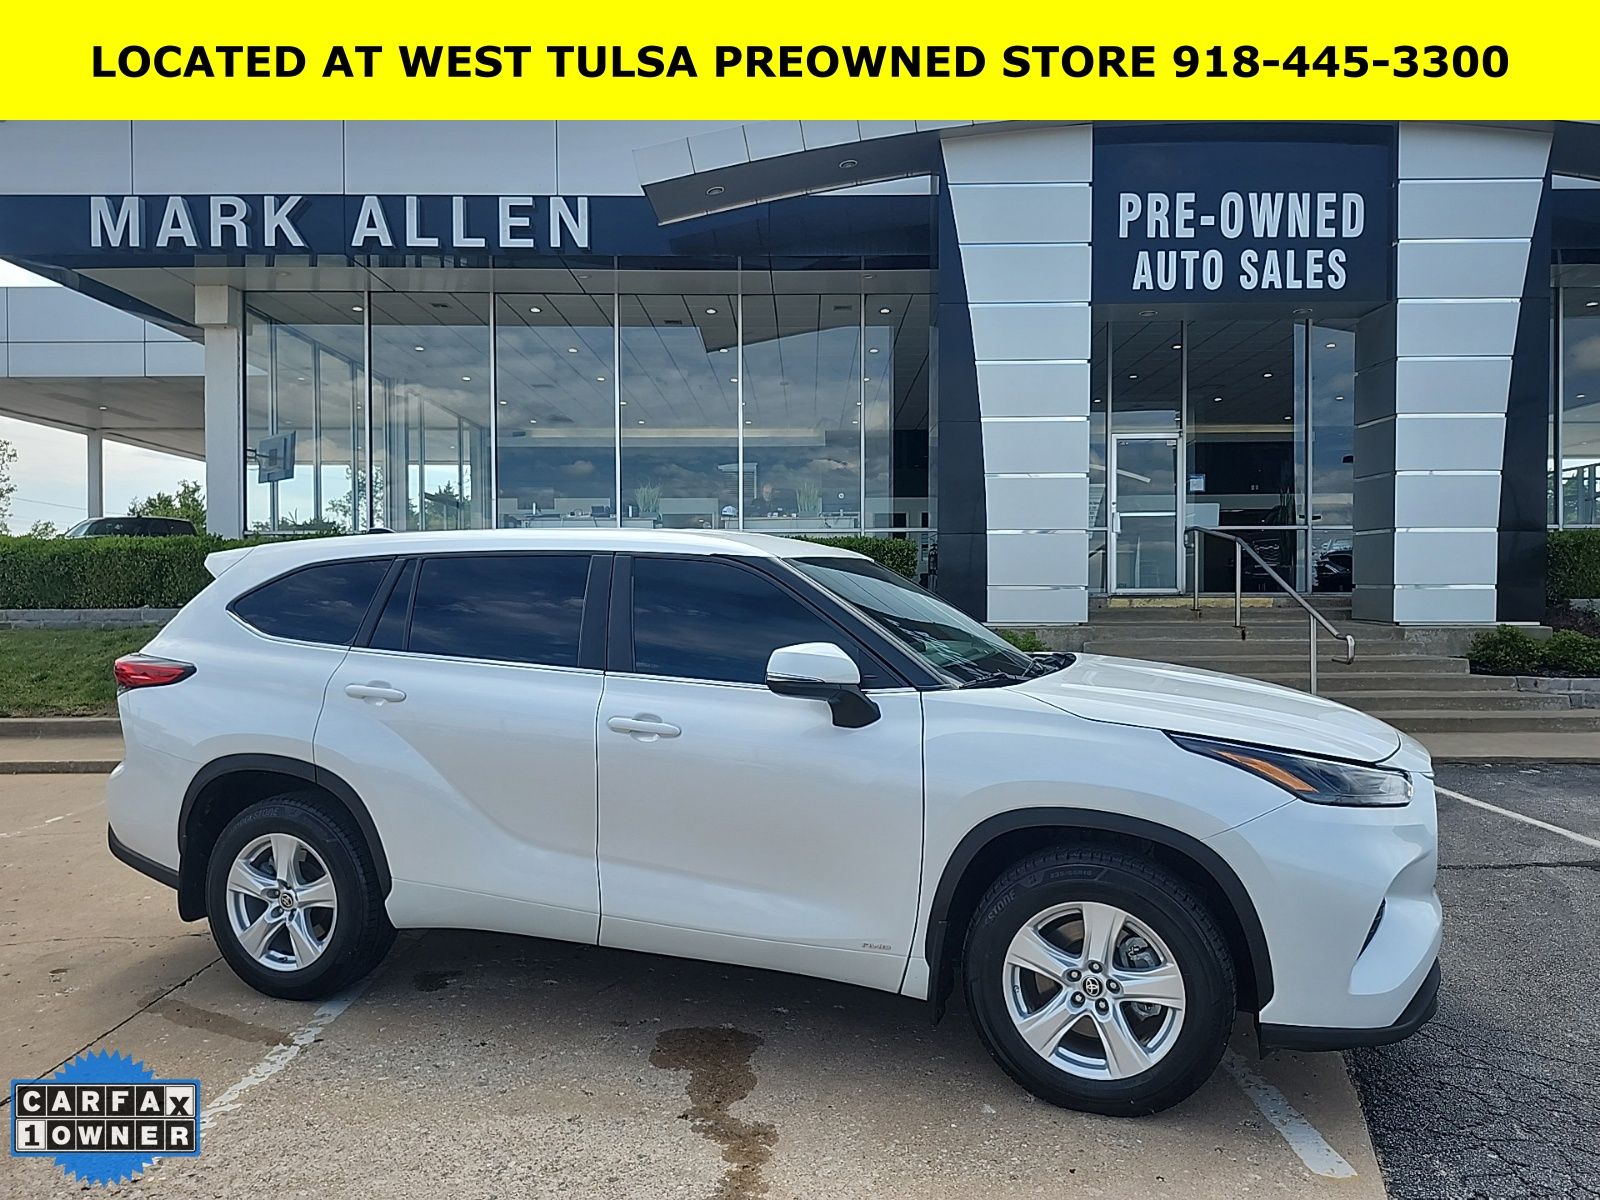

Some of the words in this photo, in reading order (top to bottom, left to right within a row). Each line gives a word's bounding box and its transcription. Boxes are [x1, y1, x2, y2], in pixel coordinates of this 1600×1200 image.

[90, 195, 306, 248] MARK
[350, 195, 592, 249] ALLEN
[1118, 191, 1366, 239] PRE-OWNED
[1132, 249, 1224, 291] AUTO
[1239, 249, 1347, 290] SALES
